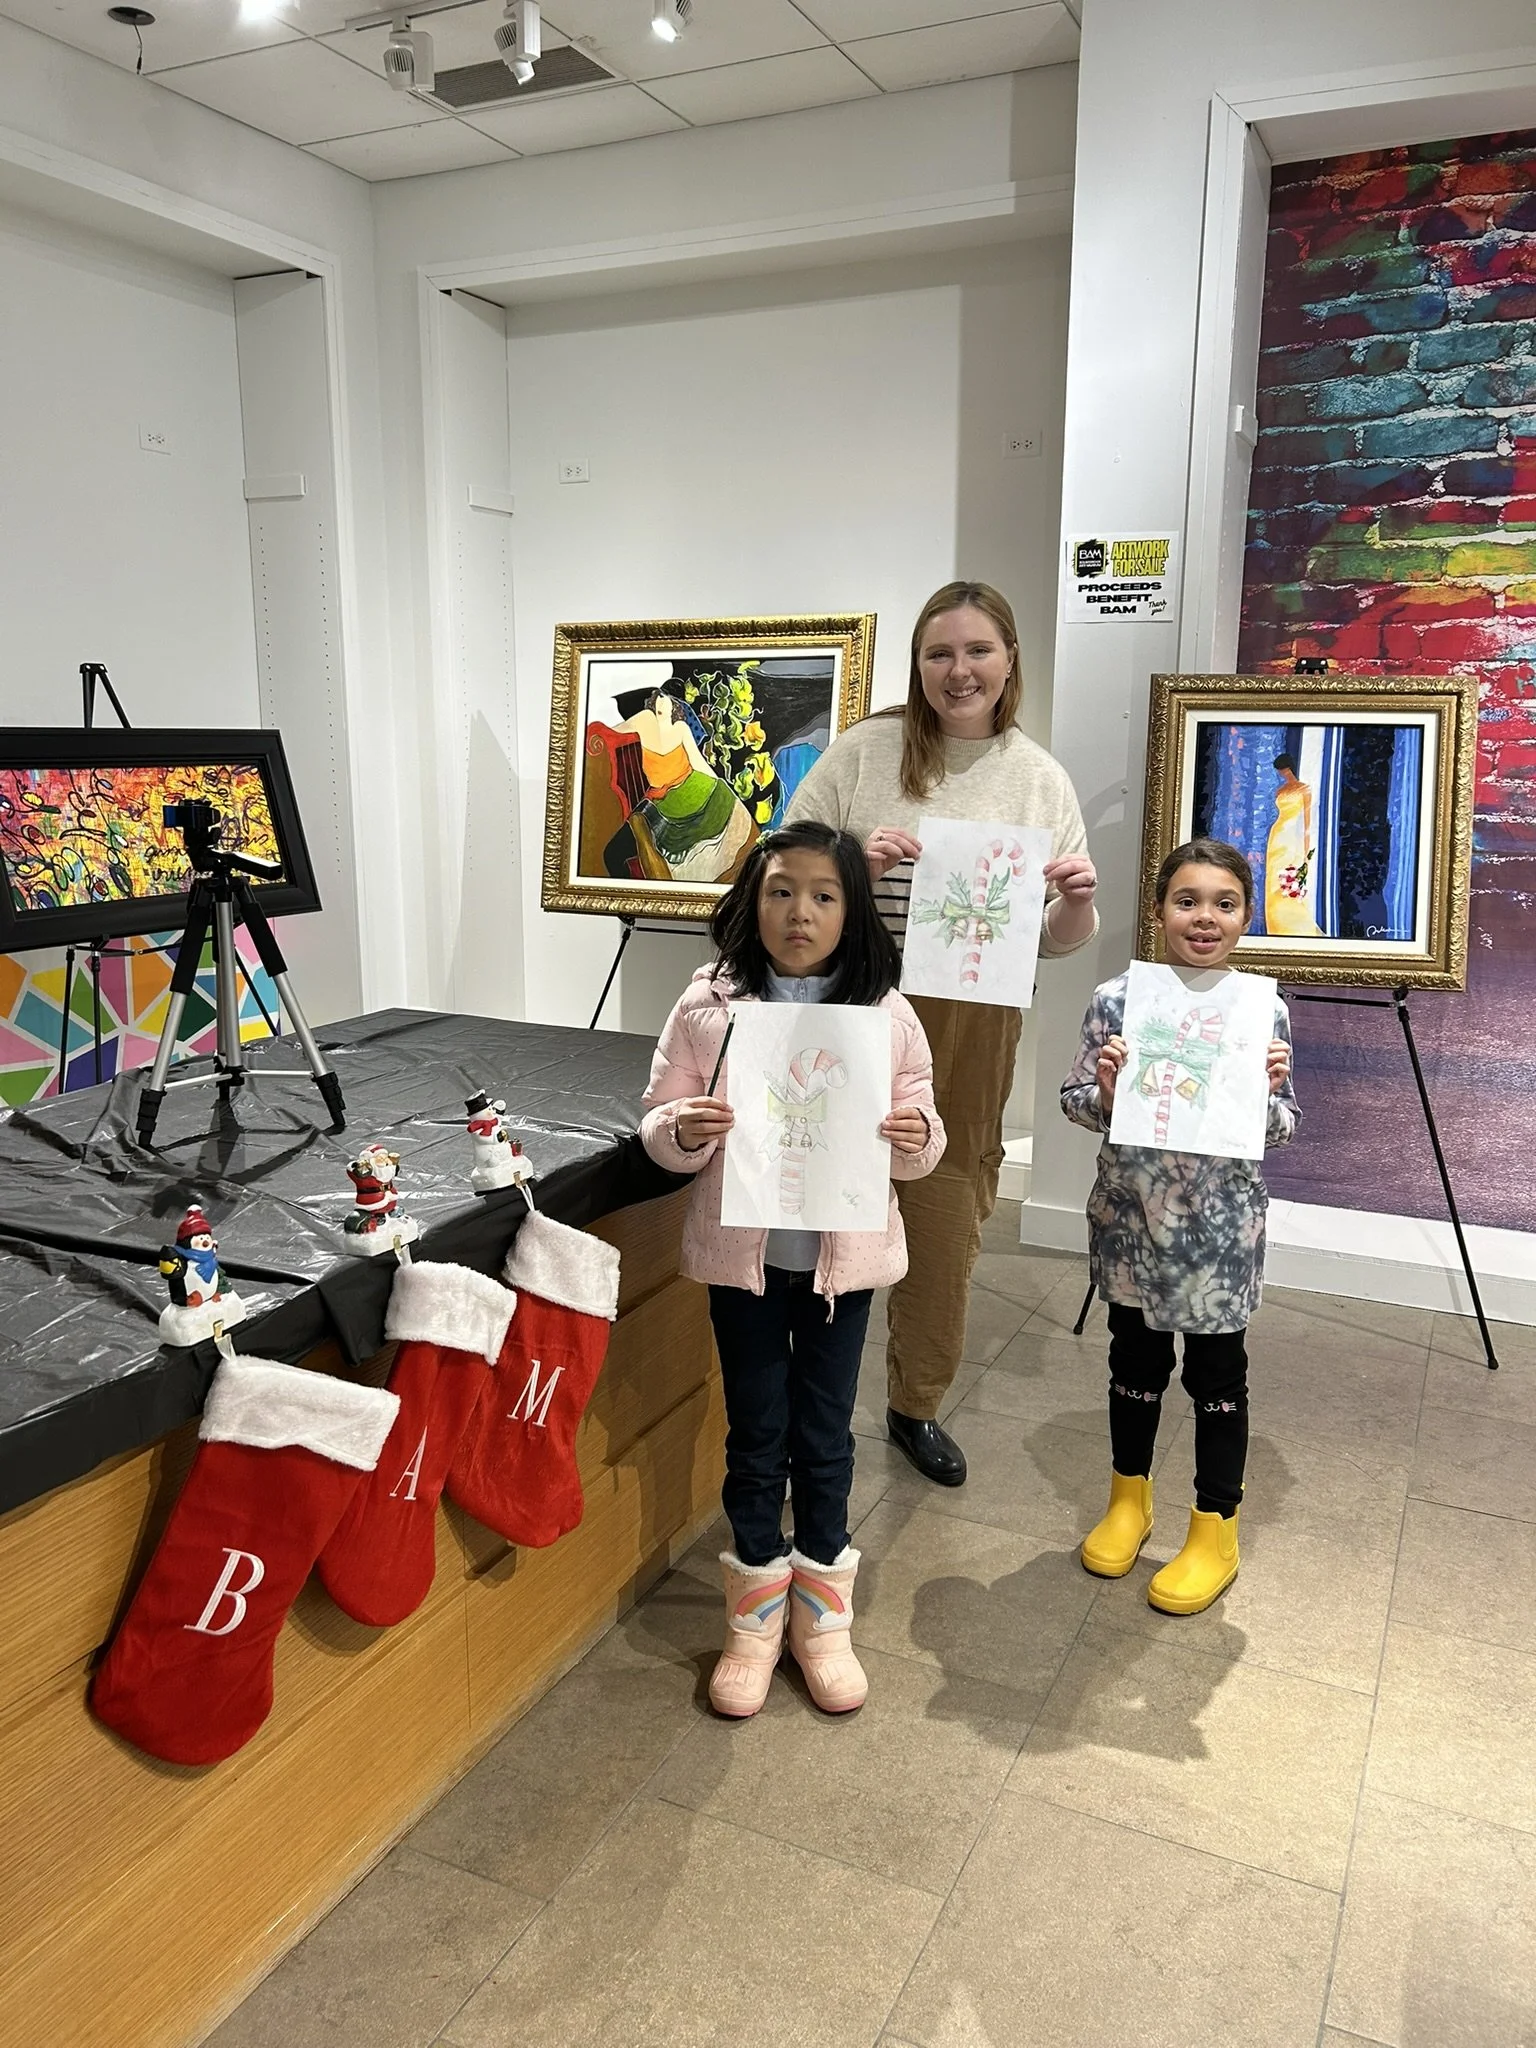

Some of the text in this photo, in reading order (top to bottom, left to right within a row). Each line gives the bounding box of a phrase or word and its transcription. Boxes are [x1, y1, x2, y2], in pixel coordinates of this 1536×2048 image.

[1079, 549, 1102, 559] BAM
[1110, 539, 1170, 560] ARTWORK
[1112, 557, 1166, 577] FOR SALE
[1078, 582, 1162, 592] PROCEEDS
[1086, 594, 1152, 603] BENEFIT
[1148, 598, 1168, 608] Thank
[1100, 605, 1137, 614] BAM
[506, 1359, 566, 1428] M
[389, 1426, 427, 1500] A
[183, 1547, 265, 1636] B
